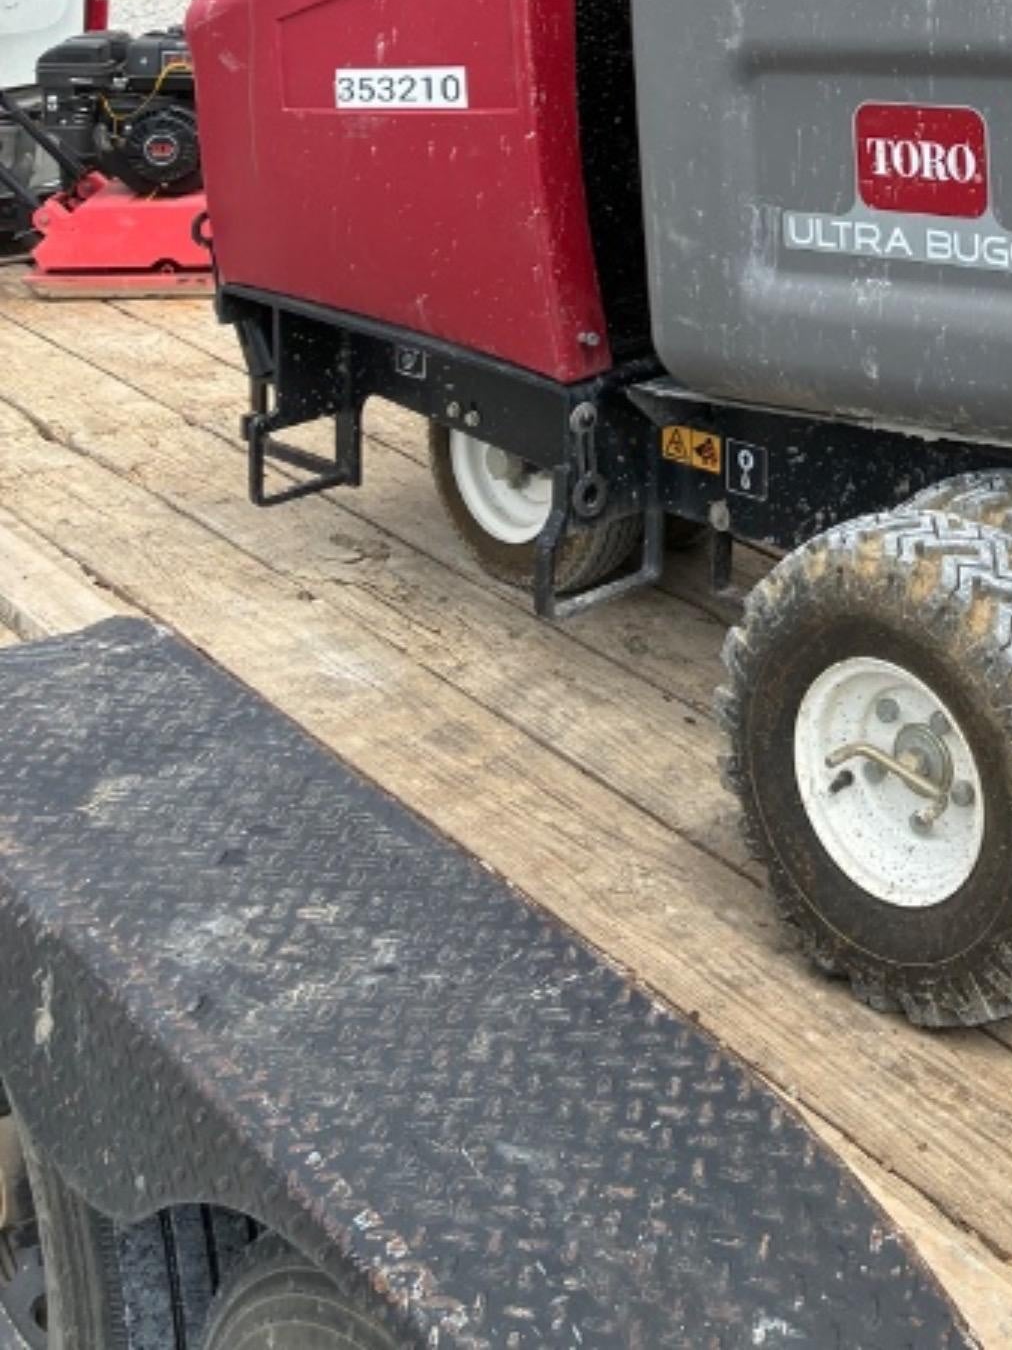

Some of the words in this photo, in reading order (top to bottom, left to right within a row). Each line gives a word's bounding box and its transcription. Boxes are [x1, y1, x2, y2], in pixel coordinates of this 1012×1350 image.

[337, 74, 460, 103] 353210
[866, 137, 978, 183] TORO
[788, 215, 913, 257] ULTRA
